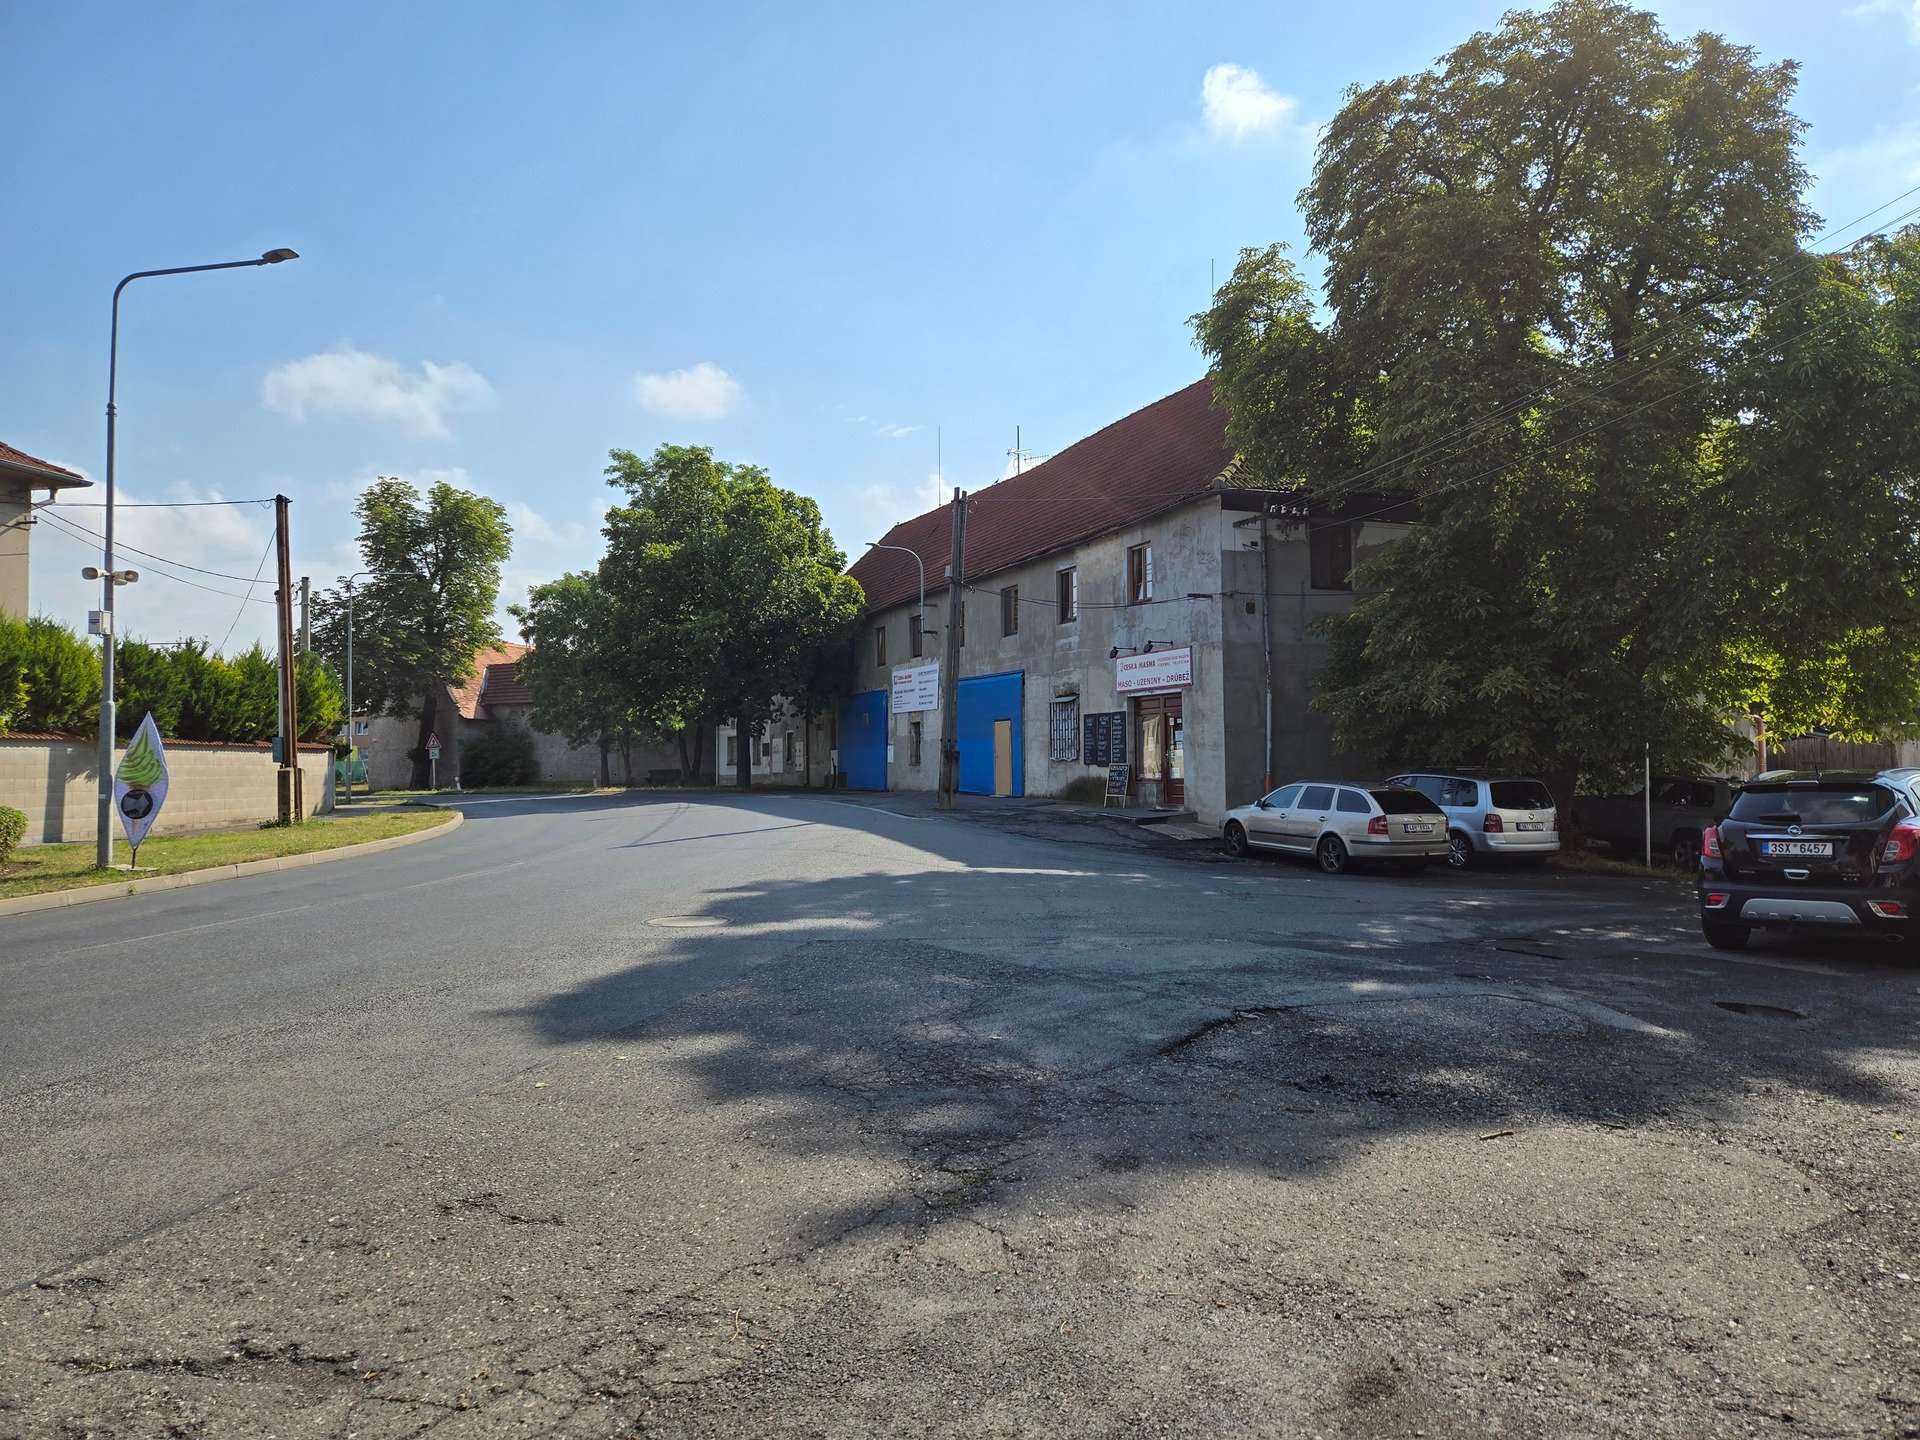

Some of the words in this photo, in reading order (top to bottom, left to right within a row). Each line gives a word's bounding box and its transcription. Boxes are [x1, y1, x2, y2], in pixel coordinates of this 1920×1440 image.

[1117, 680, 1132, 688] MASO
[1137, 677, 1161, 687] UZENINY
[1166, 670, 1190, 683] DRŮBEŽ
[1771, 843, 1791, 853] 3SX
[1799, 843, 1828, 854] 6457
